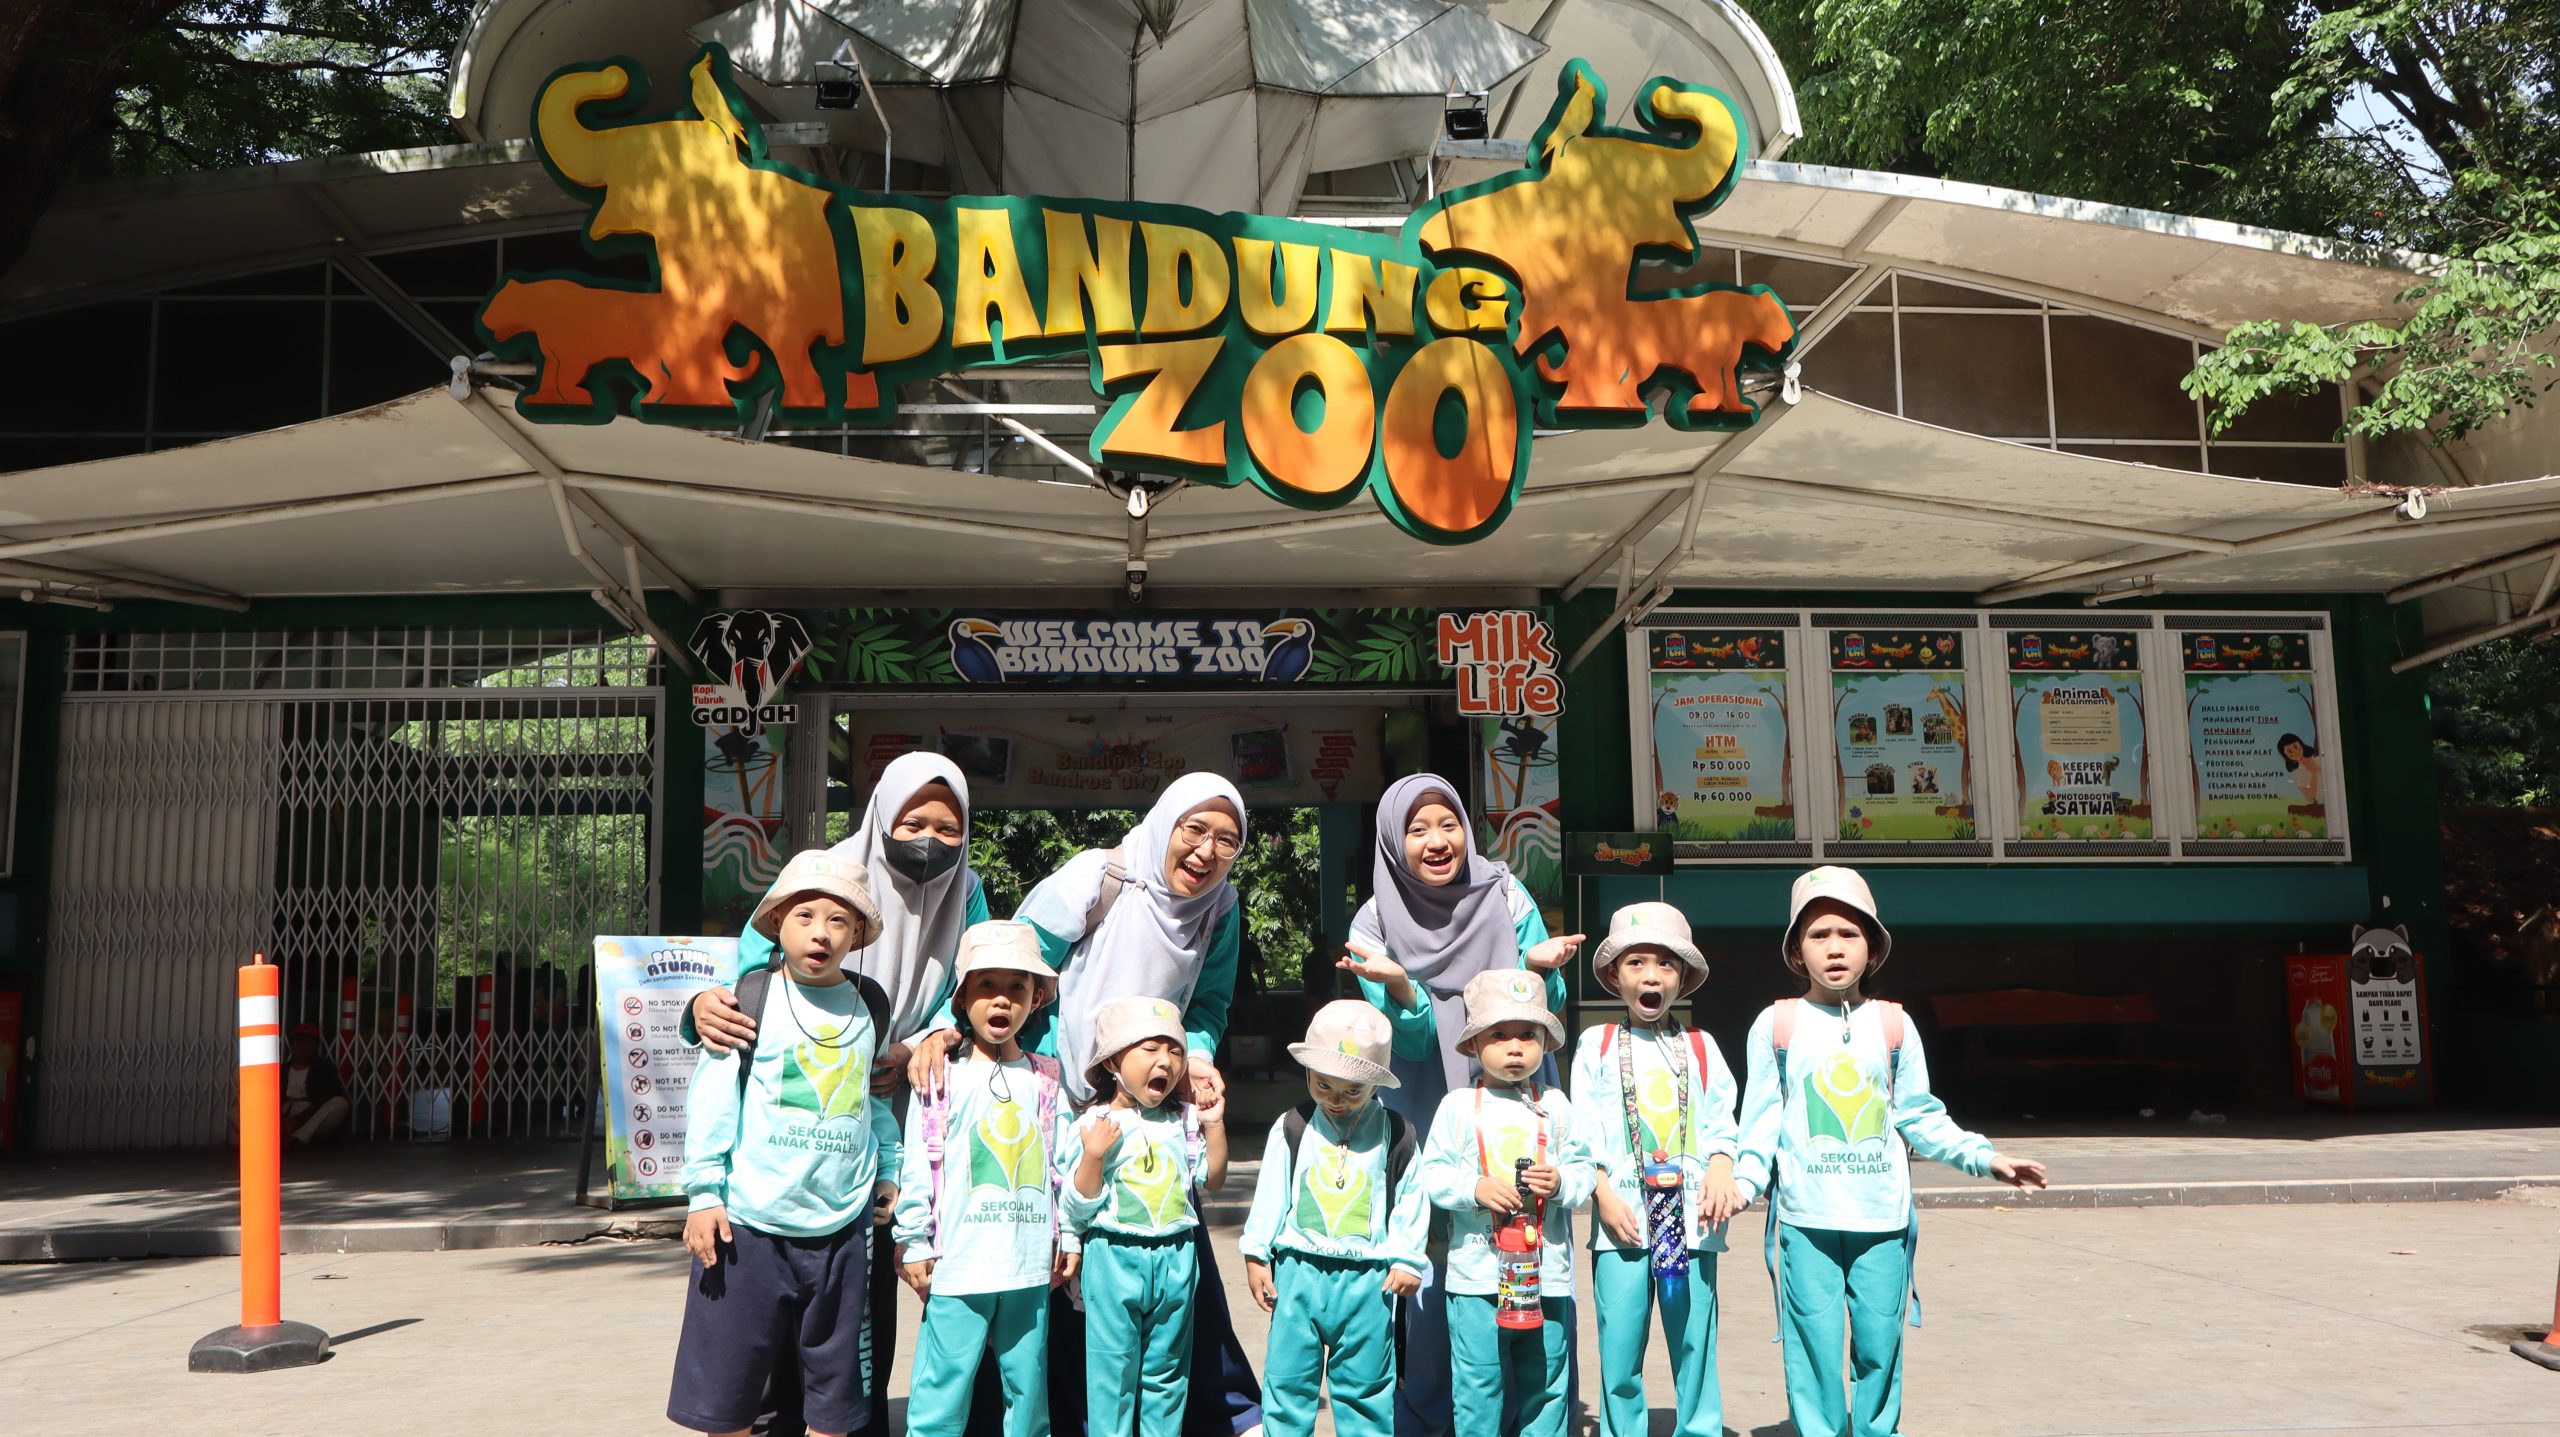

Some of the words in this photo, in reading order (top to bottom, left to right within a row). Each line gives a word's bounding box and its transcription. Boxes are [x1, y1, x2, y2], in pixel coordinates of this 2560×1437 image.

[849, 204, 1509, 365] BANDUNG
[1100, 333, 1518, 532] ZOO
[999, 620, 1201, 647] WELCOME
[1213, 620, 1266, 647] TO
[1438, 611, 1560, 667] Milk
[996, 646, 1180, 673] BANDUNG
[1192, 646, 1266, 673] ZOO
[693, 685, 714, 697] Kopi
[1458, 664, 1562, 716] Life
[2053, 688, 2104, 700] Animal
[693, 695, 725, 705] Tubruk
[1673, 696, 1695, 707] JAM
[1698, 694, 1765, 707] OPERASIONAL
[2201, 705, 2225, 713] HALLO
[2202, 716, 2255, 724] MANAGEMENT
[1705, 735, 1736, 748] HTM
[1056, 752, 1143, 773] Bandung
[1148, 751, 1186, 769] Zoo
[2062, 762, 2103, 771] KEEPER
[2206, 760, 2244, 768] PROTOKOL
[1029, 767, 1112, 790] Bandros
[2065, 772, 2103, 785] TALK
[2207, 771, 2249, 779] KESEHATAN
[2056, 801, 2114, 815] SATWA
[647, 960, 715, 976] ATURAN
[787, 1125, 852, 1142] SEKOLAH
[768, 1134, 809, 1150] ANAK
[814, 1140, 859, 1154] SHALEH
[1820, 1152, 1882, 1163] SEKOLAH
[1806, 1164, 1842, 1175] ANAK
[1847, 1162, 1892, 1174] SHALEH
[980, 1200, 1034, 1213] SEKOLAH
[964, 1212, 1002, 1223] ANAK
[1007, 1212, 1047, 1224] SHALEH
[1302, 1241, 1363, 1258] SEKOLAH
